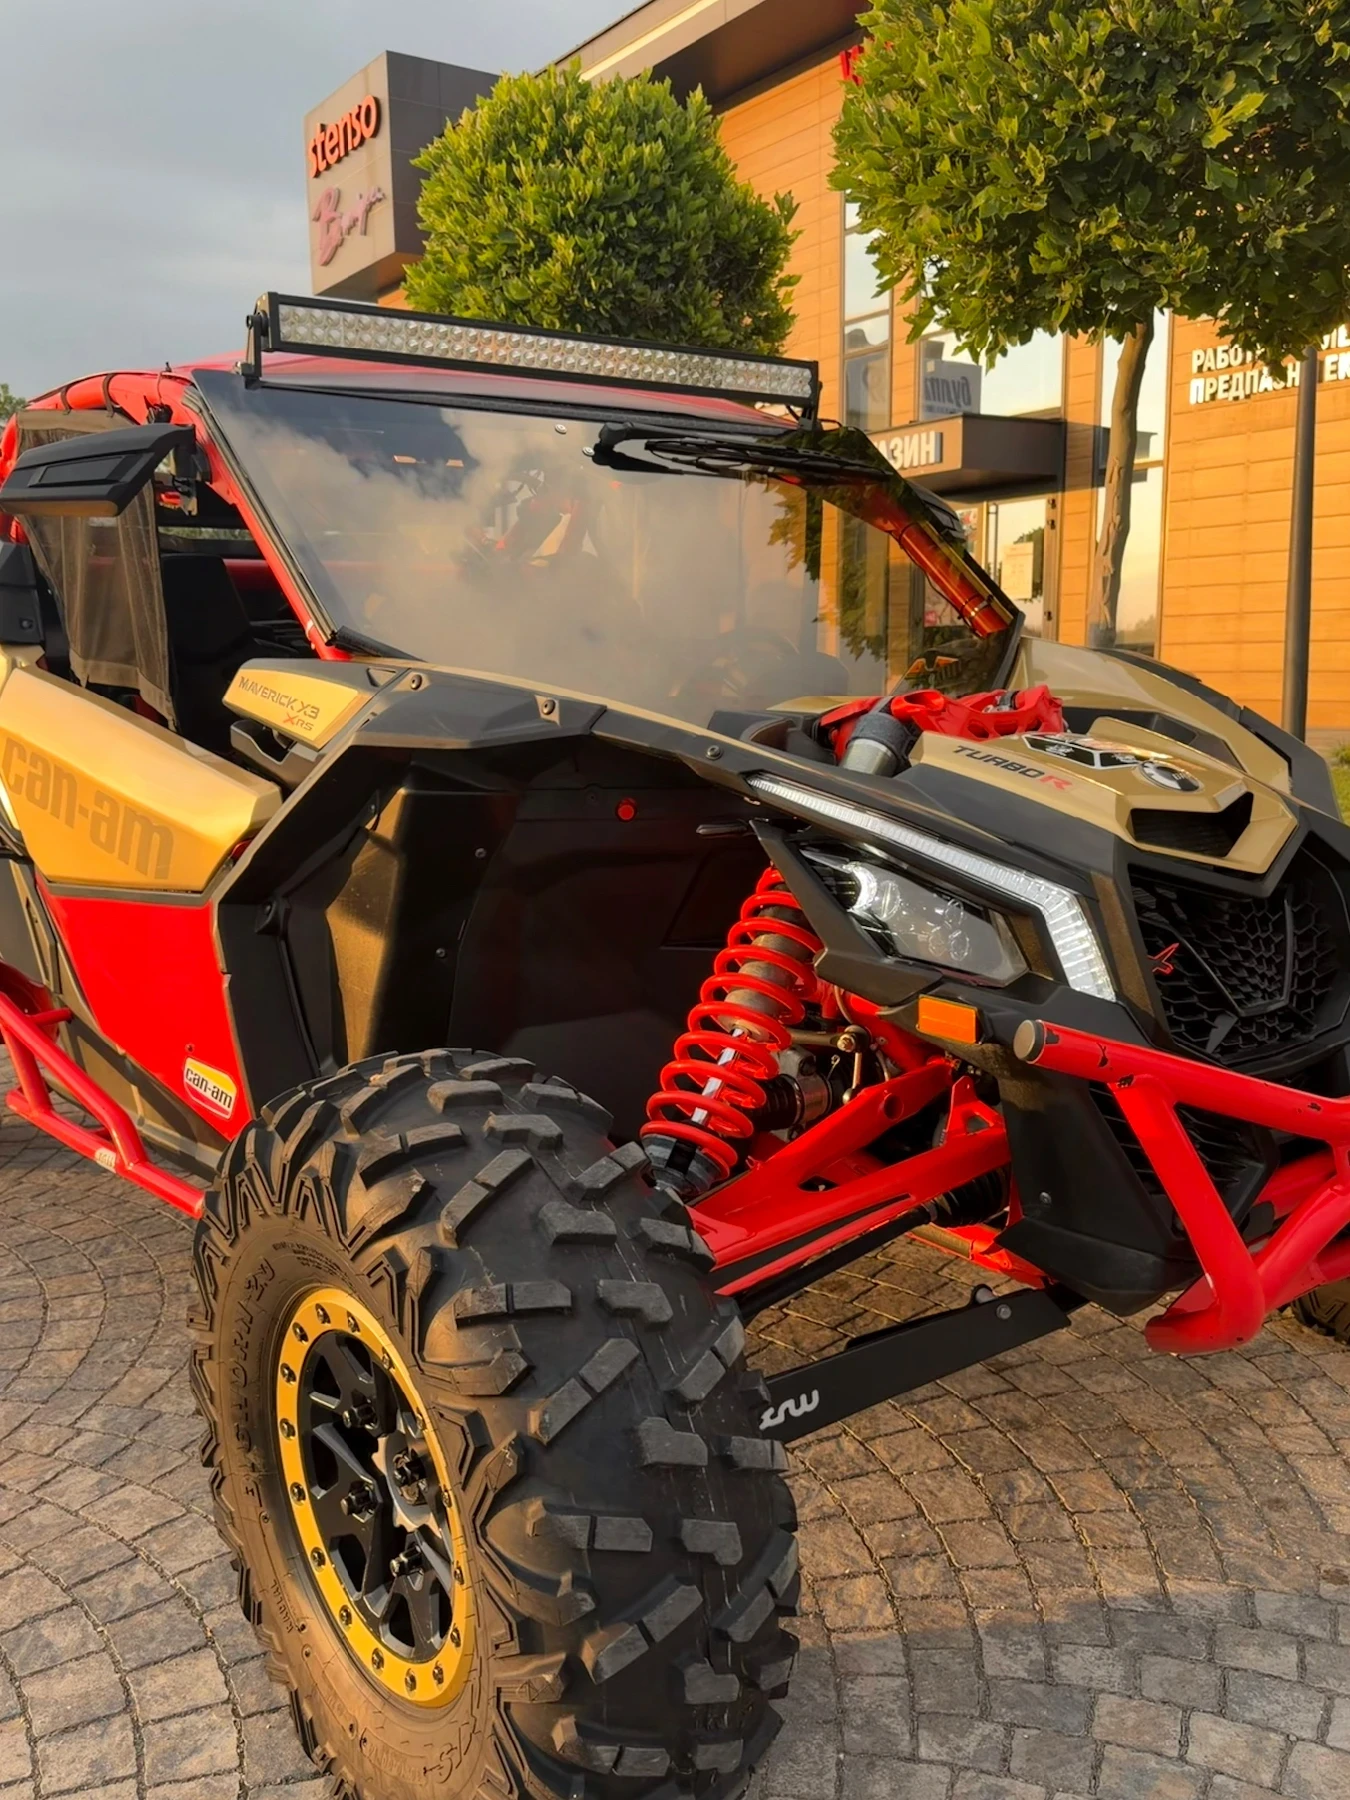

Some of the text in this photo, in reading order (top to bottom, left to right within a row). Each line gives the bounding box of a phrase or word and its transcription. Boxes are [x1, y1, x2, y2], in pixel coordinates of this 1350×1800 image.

[308, 94, 378, 178] stenso
[873, 430, 936, 470] АЗИН
[238, 676, 320, 720] MAVERICK X3
[283, 713, 315, 731] XRS
[2, 737, 174, 880] can-am
[185, 1067, 233, 1109] can-am
